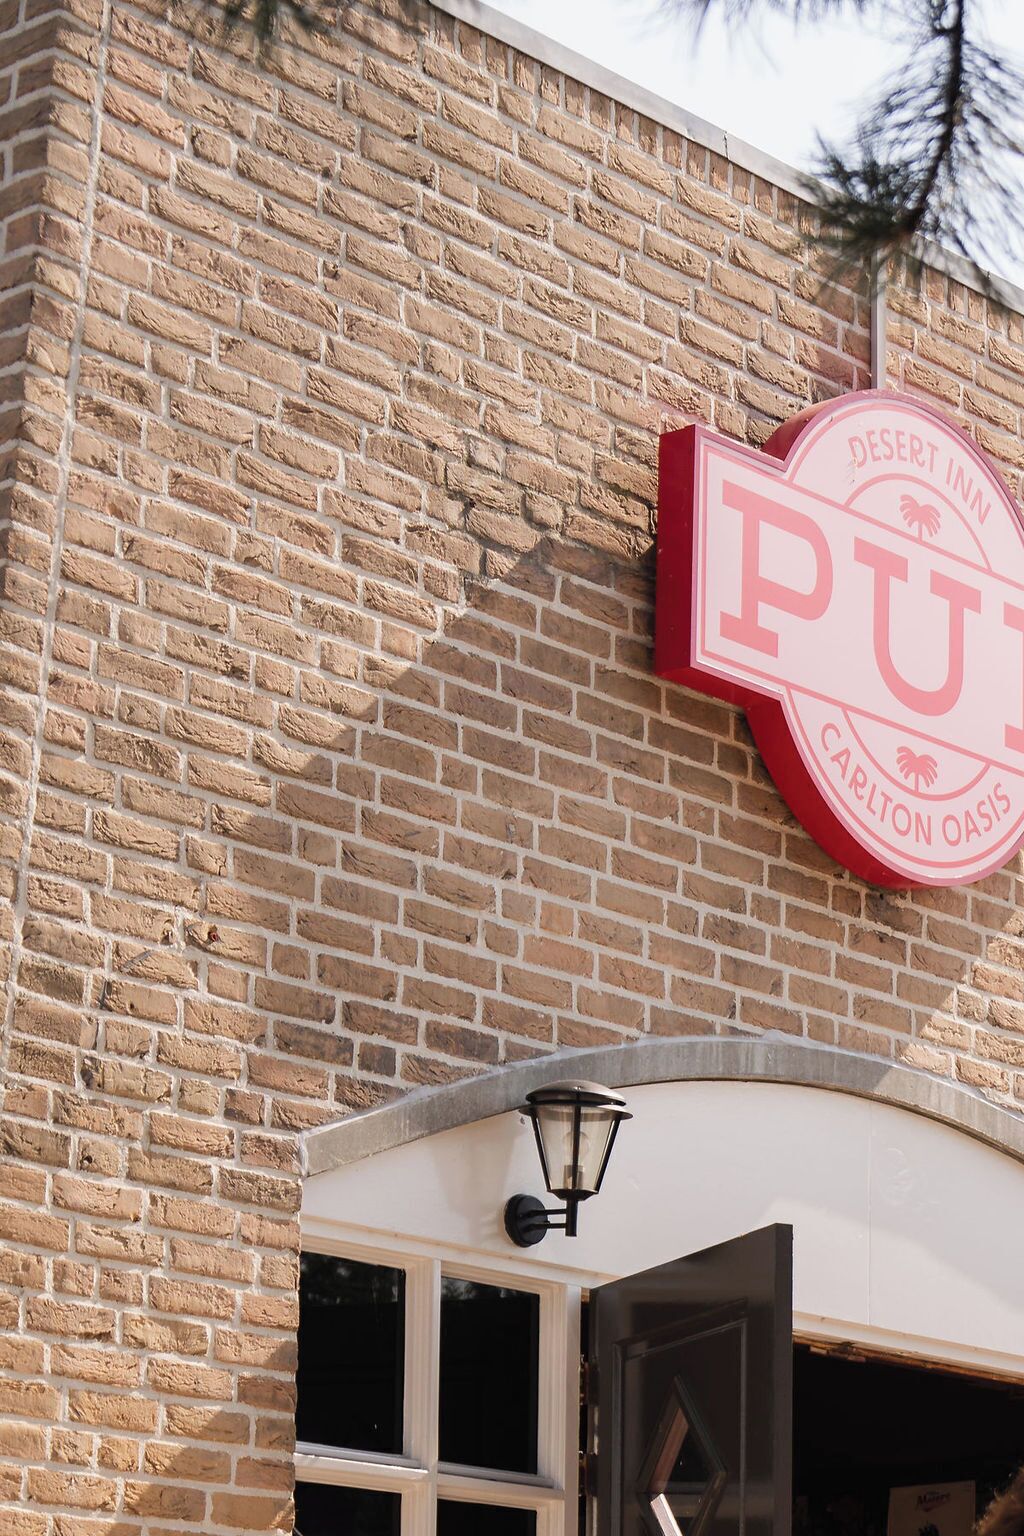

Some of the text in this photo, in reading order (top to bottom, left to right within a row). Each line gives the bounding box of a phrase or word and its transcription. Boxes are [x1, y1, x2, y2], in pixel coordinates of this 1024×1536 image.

[849, 429, 991, 525] DESERT INN
[821, 723, 1011, 847] CARLTON OASIS
